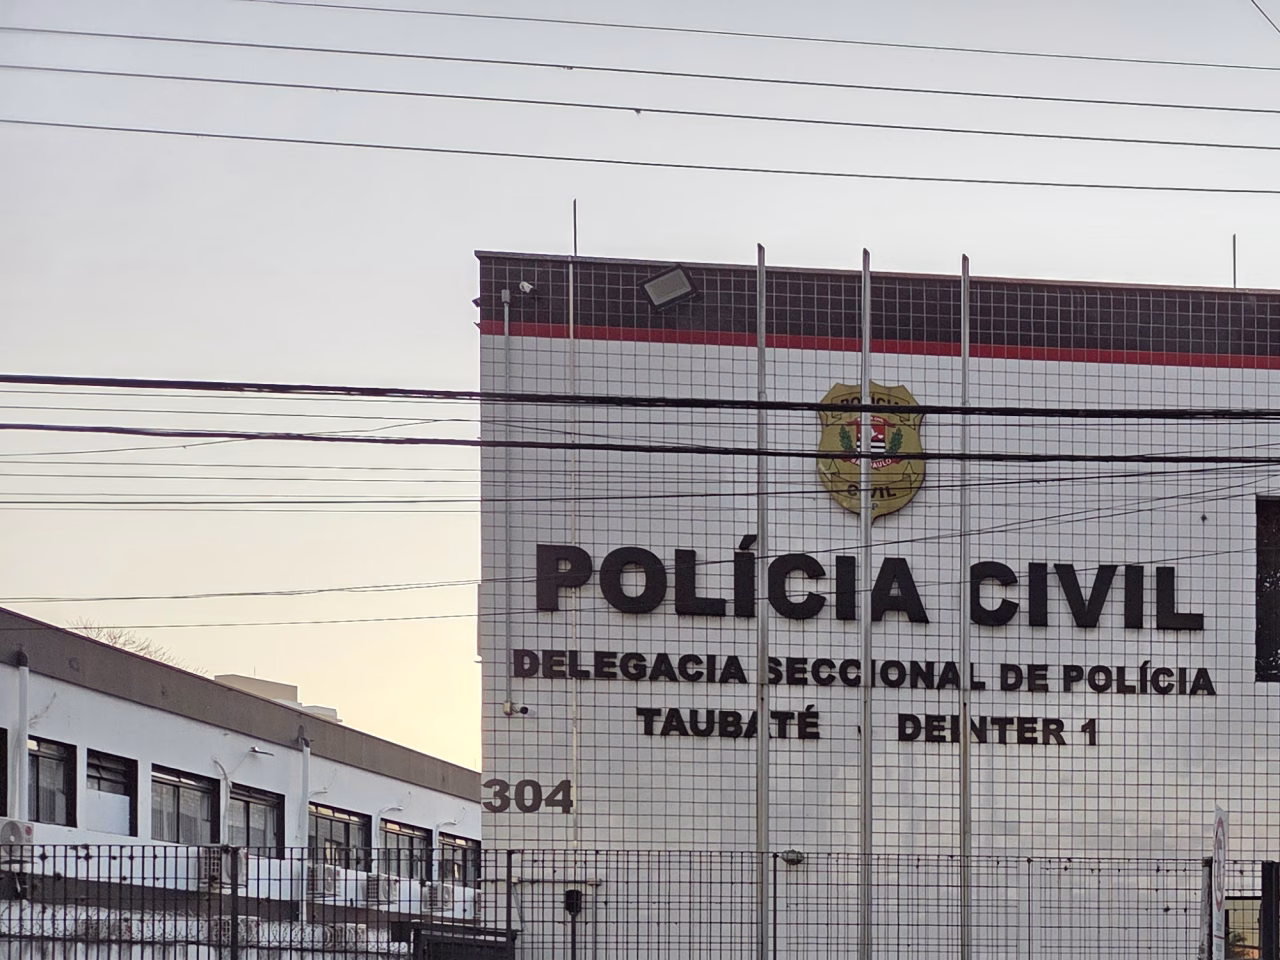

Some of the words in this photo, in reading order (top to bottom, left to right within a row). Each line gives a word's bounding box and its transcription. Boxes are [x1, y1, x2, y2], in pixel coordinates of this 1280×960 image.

[536, 534, 929, 624] POLÍCIA
[969, 561, 1204, 630] CIVIL
[513, 649, 747, 683] DELEGACIA
[1000, 663, 1048, 692] DE
[1063, 660, 1216, 696] POLÍCIA
[636, 704, 820, 739] TAUBATÉ
[1081, 719, 1097, 745] 1
[482, 778, 573, 814] 304
